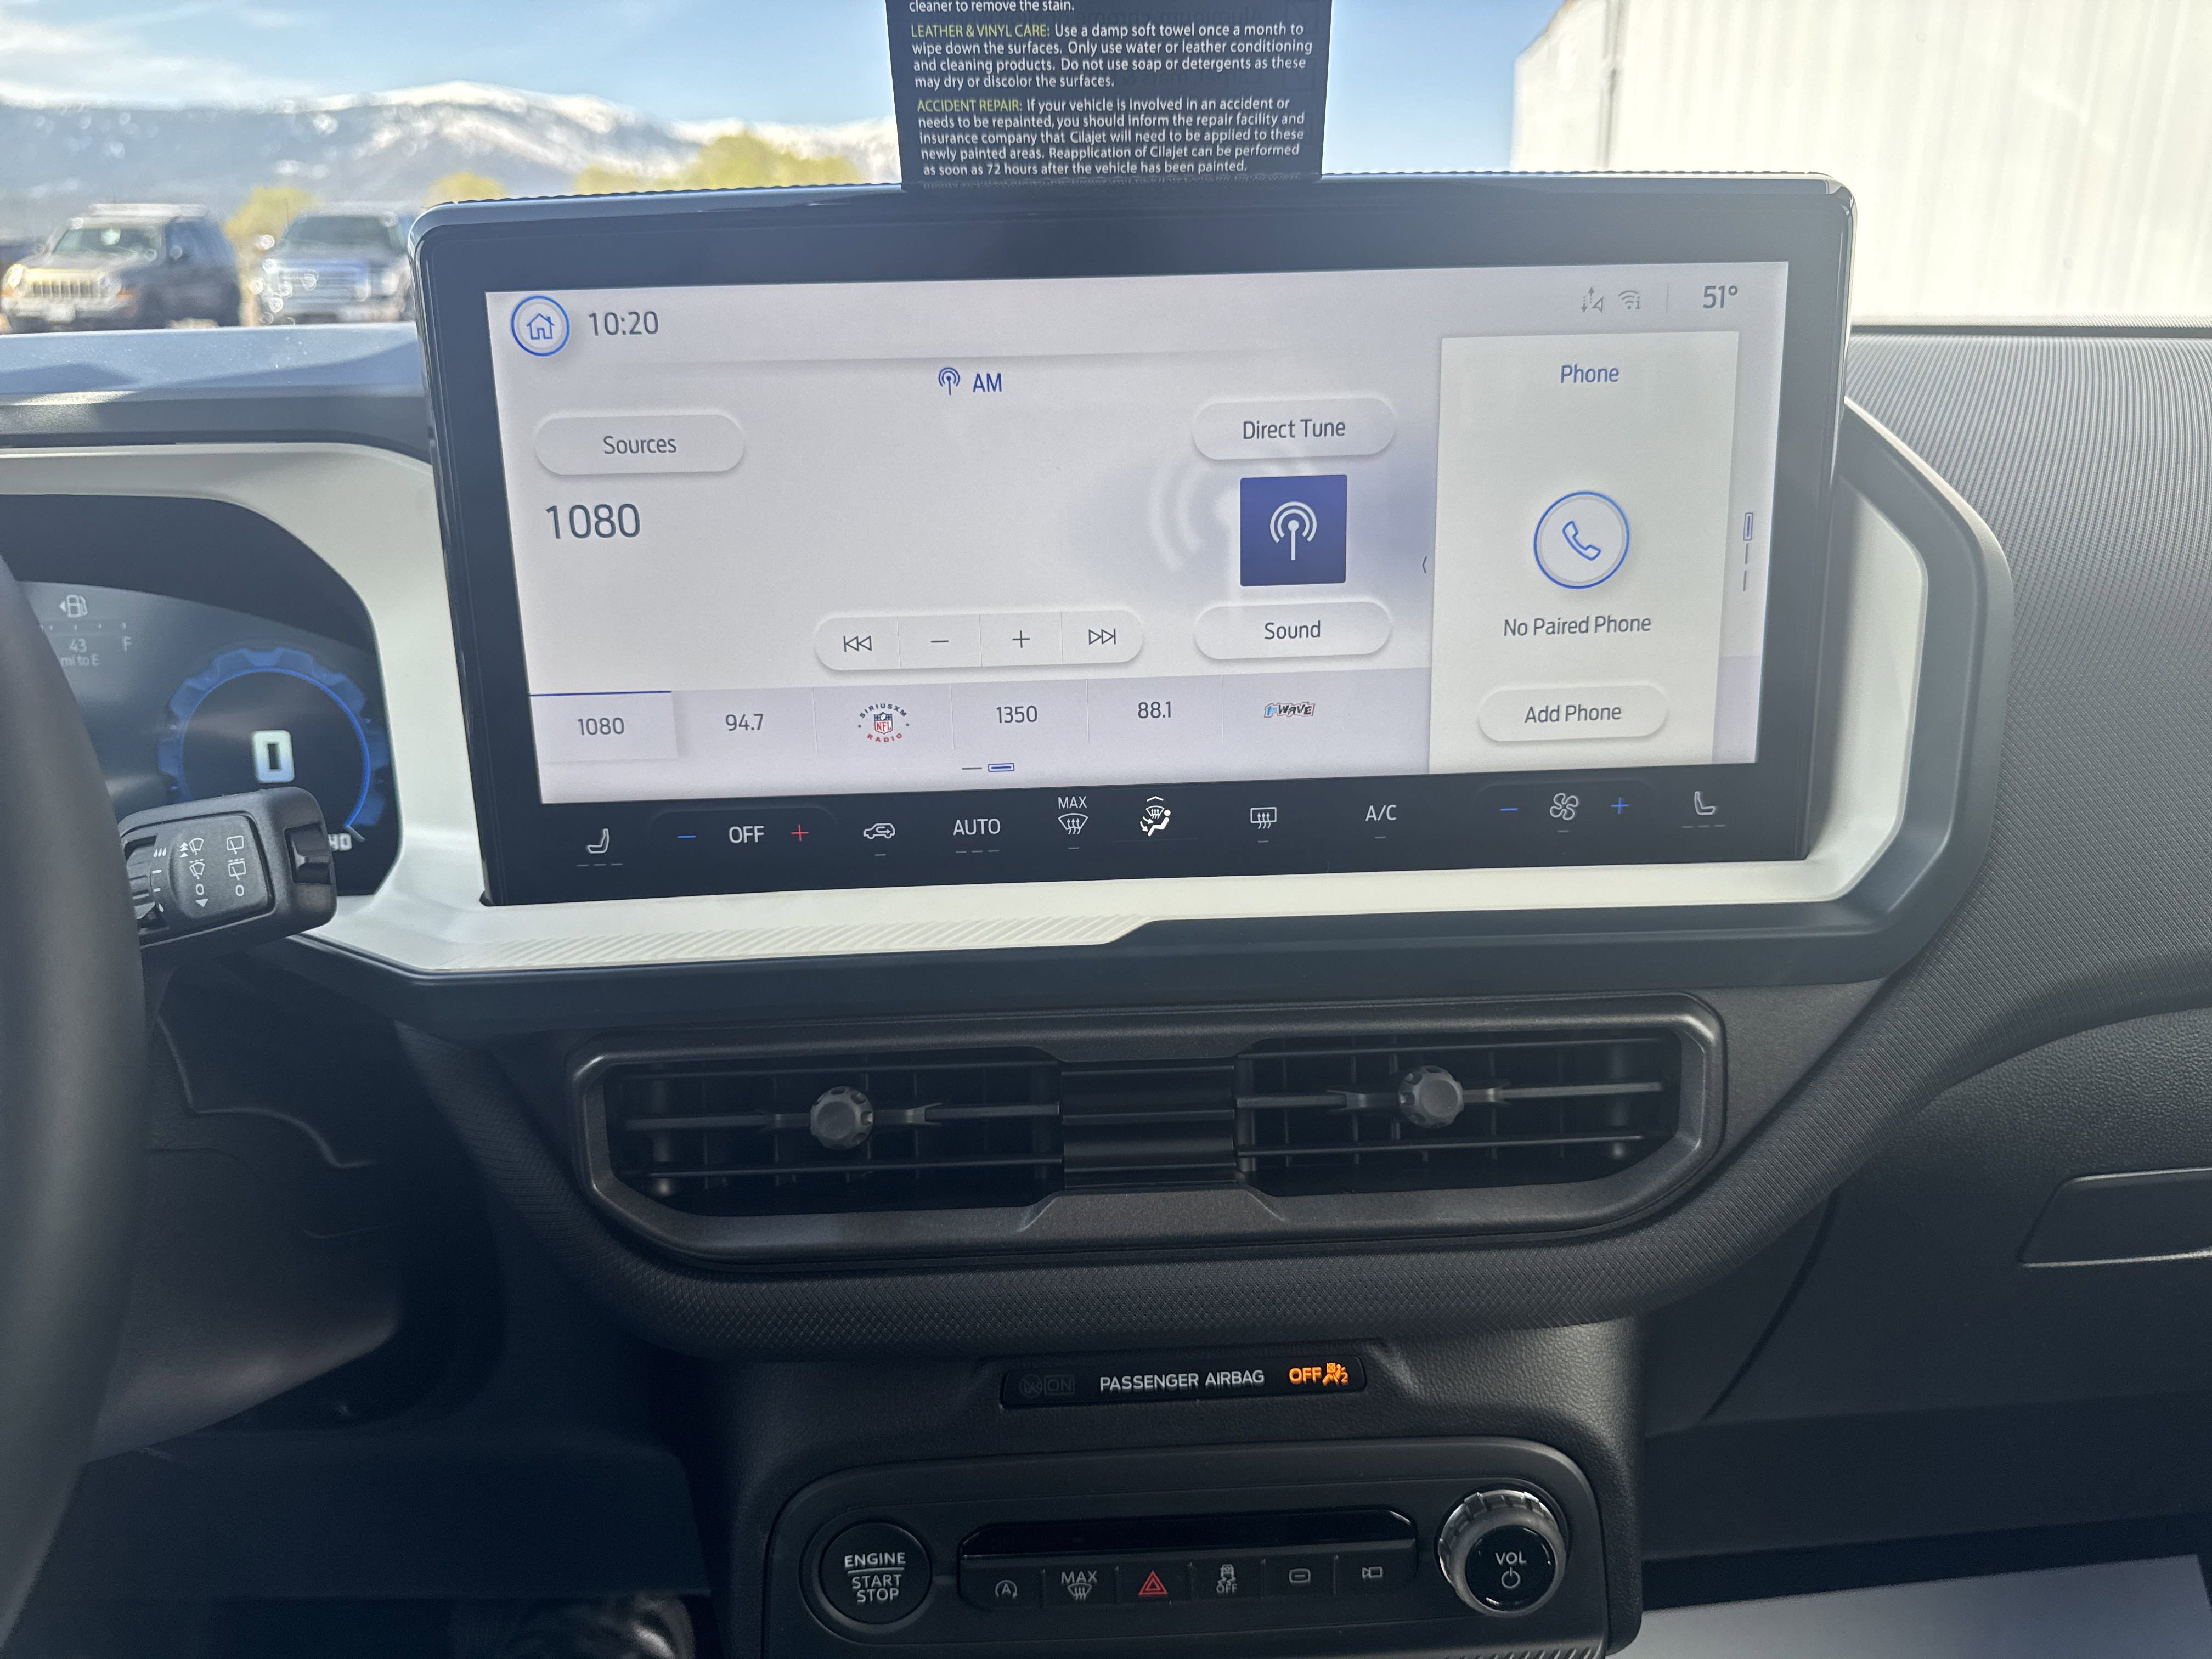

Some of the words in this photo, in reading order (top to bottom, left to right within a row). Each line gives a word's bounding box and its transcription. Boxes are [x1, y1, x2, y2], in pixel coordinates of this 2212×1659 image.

[909, 0, 952, 12] cleaner
[956, 0, 968, 12] to
[971, 1, 1016, 12] remove
[1019, 0, 1039, 11] the
[1042, 0, 1074, 11] stain.
[911, 24, 963, 38] LEATHER
[966, 24, 974, 37] &
[977, 24, 1012, 37] VINYL
[1015, 24, 1049, 37] CARE:
[1055, 22, 1077, 37] Use
[1081, 26, 1087, 37] a
[1092, 22, 1128, 39] damp
[1132, 22, 1156, 37] soft
[1160, 22, 1194, 36] towel
[1199, 25, 1229, 36] once
[1233, 25, 1240, 36] a
[1245, 21, 1286, 36] month
[1290, 23, 1304, 35] to
[912, 41, 942, 58] wipe
[945, 41, 980, 55] down
[984, 41, 1004, 54] the
[1008, 41, 1062, 54] surfaces.
[1068, 40, 1097, 57] Only
[1101, 43, 1122, 53] use
[1126, 41, 1161, 53] water
[1165, 43, 1178, 53] or
[1182, 40, 1227, 54] leather
[1231, 39, 1312, 55] conditioning
[914, 58, 936, 71] and
[940, 57, 992, 74] cleaning
[997, 57, 1055, 74] products.
[1061, 57, 1079, 70] Do
[1082, 58, 1103, 70] not
[1107, 59, 1128, 70] use
[1132, 59, 1161, 72] soap
[1166, 59, 1178, 70] or
[1182, 55, 1251, 72] detergents
[1255, 58, 1267, 69] as
[1272, 55, 1306, 69] these
[915, 76, 940, 91] may
[944, 74, 963, 91] dry
[967, 76, 980, 87] or
[983, 74, 1032, 88] discolor
[1036, 74, 1056, 87] the
[1060, 73, 1114, 87] surfaces.
[917, 99, 976, 112] ACCIDENT
[979, 99, 1022, 112] REPAIR:
[1027, 98, 1035, 111] If
[1038, 101, 1066, 114] your
[1069, 97, 1113, 113] vehicle
[1117, 98, 1126, 112] is
[1130, 97, 1182, 112] involved
[1187, 97, 1197, 110] in
[1201, 99, 1216, 110] an
[1220, 96, 1273, 111] accident
[1277, 98, 1290, 109] or
[918, 115, 954, 128] needs
[958, 116, 970, 128] to
[973, 115, 989, 128] be
[992, 114, 1054, 130] repainted,
[1057, 117, 1079, 129] you
[1083, 114, 1124, 127] should
[1128, 113, 1169, 127] inform
[1173, 112, 1193, 127] the
[1197, 113, 1233, 128] repair
[1237, 112, 1279, 128] facility
[1282, 111, 1305, 125] and
[919, 131, 978, 144] insurance
[981, 129, 1037, 145] company
[1041, 129, 1065, 143] that
[1070, 130, 1106, 145] Cilajet
[1110, 129, 1131, 142] will
[1136, 128, 1165, 142] need
[1169, 129, 1182, 142] to
[1186, 128, 1200, 142] be
[1204, 127, 1251, 143] applied
[1254, 128, 1267, 142] to
[1271, 127, 1305, 141] these
[921, 146, 956, 162] newly
[960, 146, 1006, 162] painted
[1009, 146, 1044, 159] areas.
[1049, 145, 1131, 161] Reapplication
[1135, 145, 1147, 157] of
[1150, 144, 1188, 160] Cilajet
[1192, 146, 1212, 157] can
[1217, 143, 1231, 156] be
[1235, 143, 1300, 159] performed
[923, 166, 935, 176] as
[939, 165, 967, 175] soon
[971, 165, 983, 175] as
[986, 163, 1001, 175] 72
[1004, 162, 1037, 174] hours
[1041, 162, 1068, 174] after
[1072, 162, 1091, 174] the
[1095, 161, 1137, 174] vehicle
[1141, 161, 1160, 174] has
[1165, 160, 1194, 172] been
[1198, 160, 1247, 176] painted.
[588, 311, 659, 336] 10:20
[973, 373, 1003, 393] AM
[1560, 365, 1620, 384] Phone
[1243, 420, 1295, 439] Direct
[1300, 419, 1346, 437] Tune
[603, 436, 678, 455] Sources
[545, 504, 641, 539] 1080
[1264, 620, 1321, 640] Sound
[1503, 619, 1528, 637] No
[1533, 616, 1589, 635] Paired
[1594, 614, 1651, 634] Phone
[70, 638, 87, 653] 43
[860, 703, 907, 718] SIRIUSXM
[996, 705, 1038, 724] 1350
[1138, 701, 1172, 719] 88.1
[1524, 706, 1560, 724] Add
[1565, 704, 1622, 722] Phone
[577, 717, 625, 736] 1080
[725, 714, 764, 731] 94.7
[876, 721, 892, 731] NFL
[867, 733, 902, 743] RADIO
[1058, 797, 1087, 809] MAX
[1365, 804, 1397, 821] A/C
[729, 826, 764, 843] OFF
[953, 818, 1001, 836] AUTO
[1099, 1373, 1199, 1392] PASSENGER
[1204, 1369, 1265, 1387] AIRBAG
[1289, 1367, 1322, 1384] OFF
[844, 1552, 906, 1568] ENGINE
[1496, 1551, 1527, 1565] VOL
[851, 1574, 902, 1590] START
[1060, 1570, 1097, 1584] MAX
[856, 1588, 900, 1604] STOP
[1216, 1583, 1238, 1594] OFF
